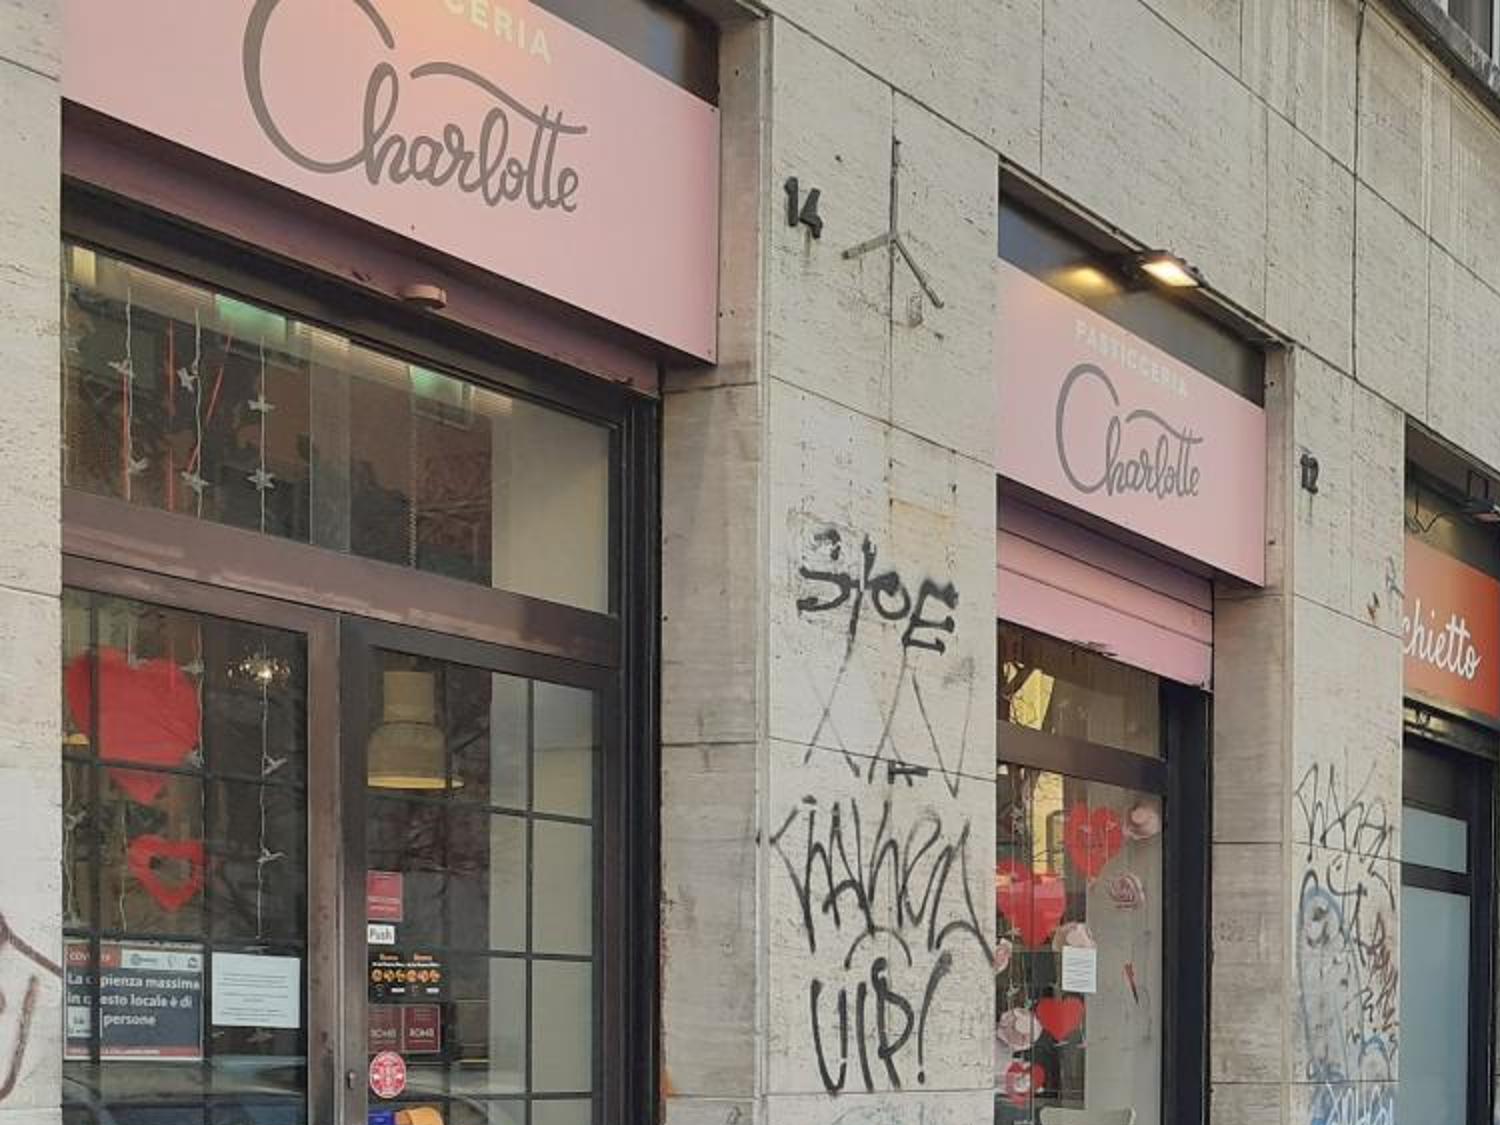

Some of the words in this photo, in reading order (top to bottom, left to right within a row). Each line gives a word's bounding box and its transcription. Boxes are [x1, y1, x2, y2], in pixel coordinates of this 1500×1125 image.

[243, 0, 588, 213] Charlotte
[1055, 363, 1204, 498] Charlotte
[67, 972, 83, 985] La
[85, 973, 143, 988] cpienza
[146, 975, 200, 990] massima
[67, 991, 80, 1005] in
[83, 993, 128, 1008] qesto
[130, 993, 167, 1008] locale
[179, 995, 193, 1009] di
[103, 1013, 157, 1027] persone
